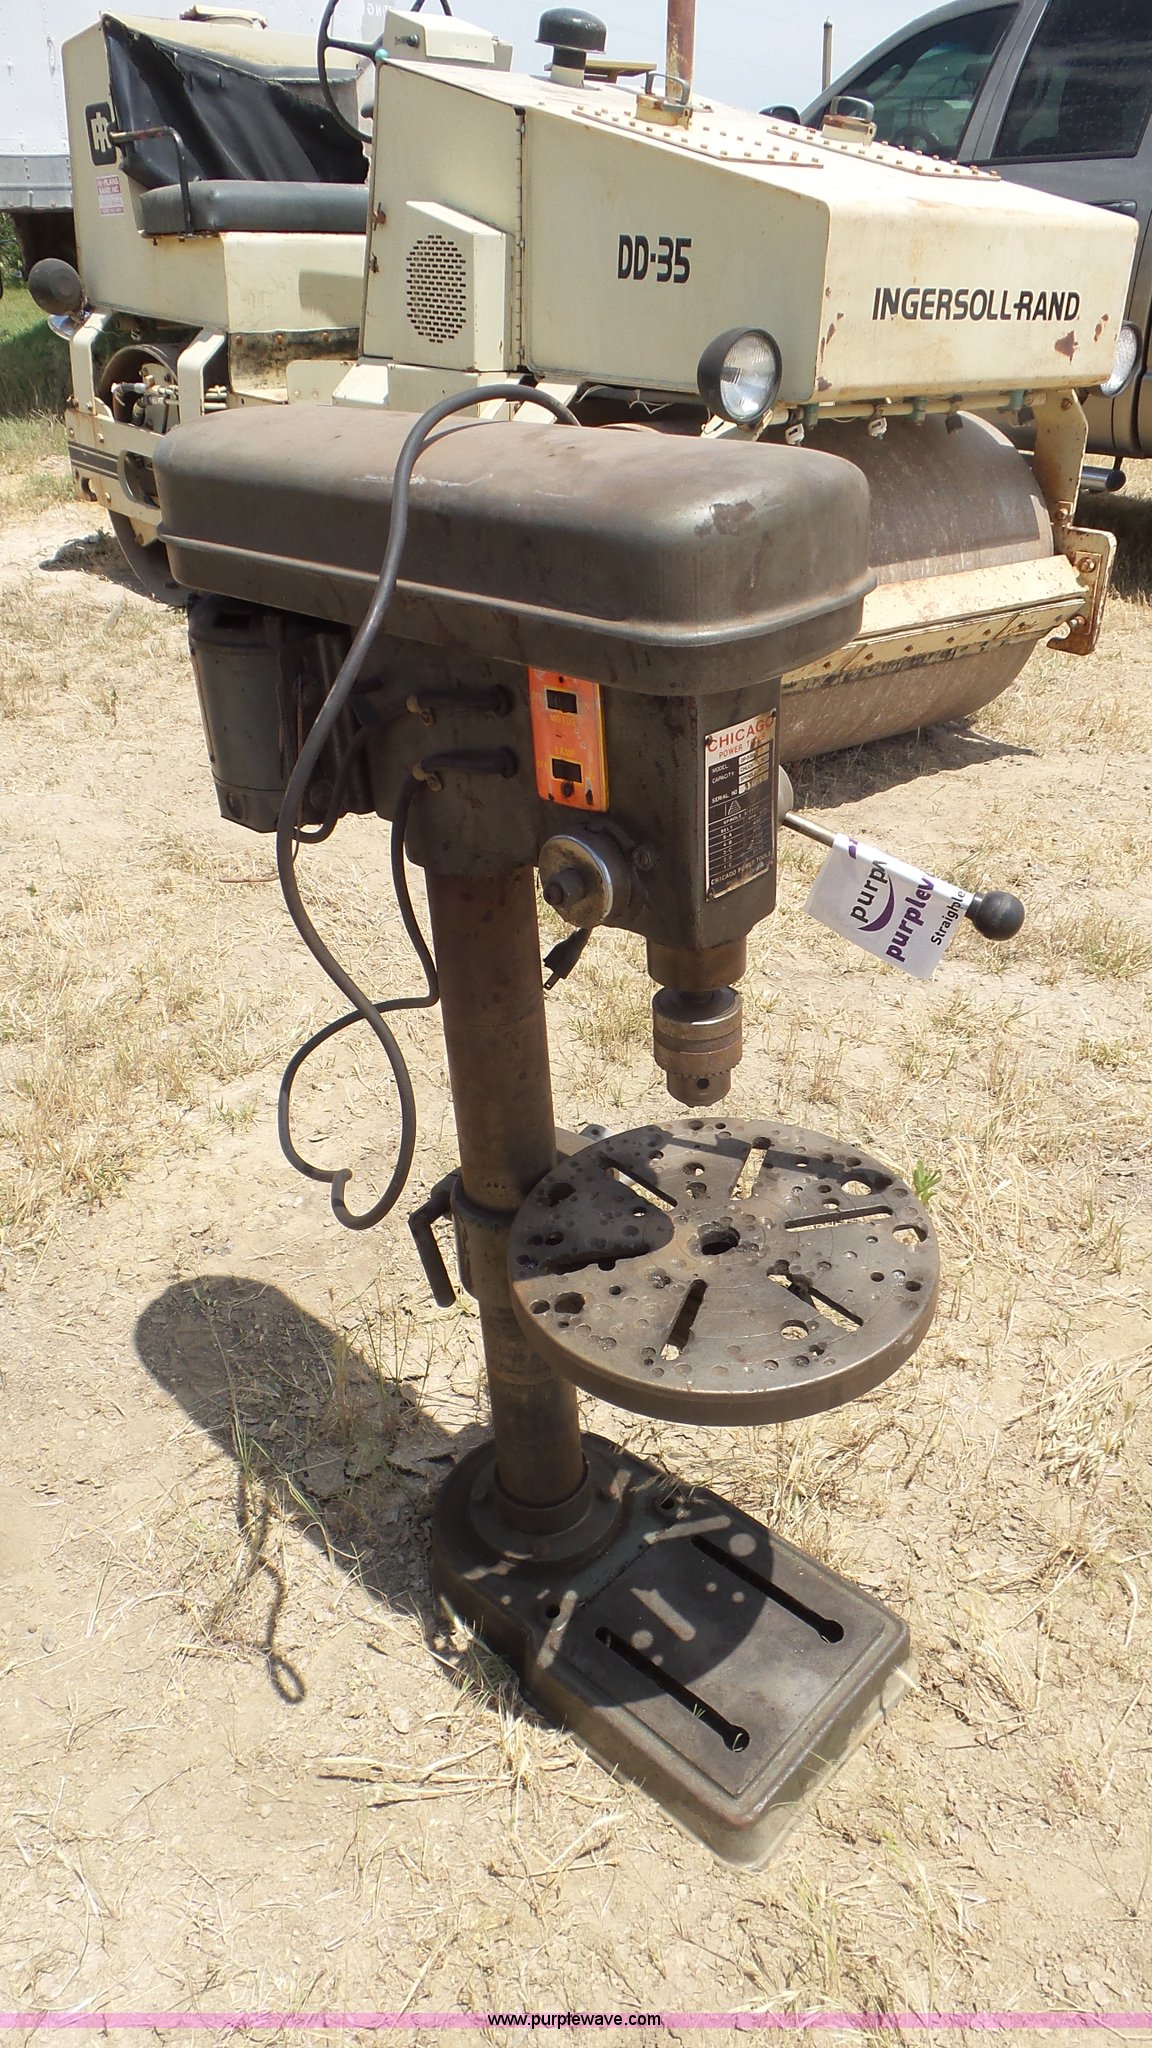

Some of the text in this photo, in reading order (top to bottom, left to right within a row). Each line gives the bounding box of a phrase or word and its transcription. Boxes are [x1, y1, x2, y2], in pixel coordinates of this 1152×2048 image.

[617, 234, 692, 284] DD-35
[872, 287, 1080, 321] INGERSOLL-RAND
[707, 715, 774, 752] CHICAGO
[719, 744, 743, 760] POWER
[712, 764, 729, 774] MODEL
[712, 771, 735, 784] CAPACITY
[711, 870, 737, 885] CHICAGO
